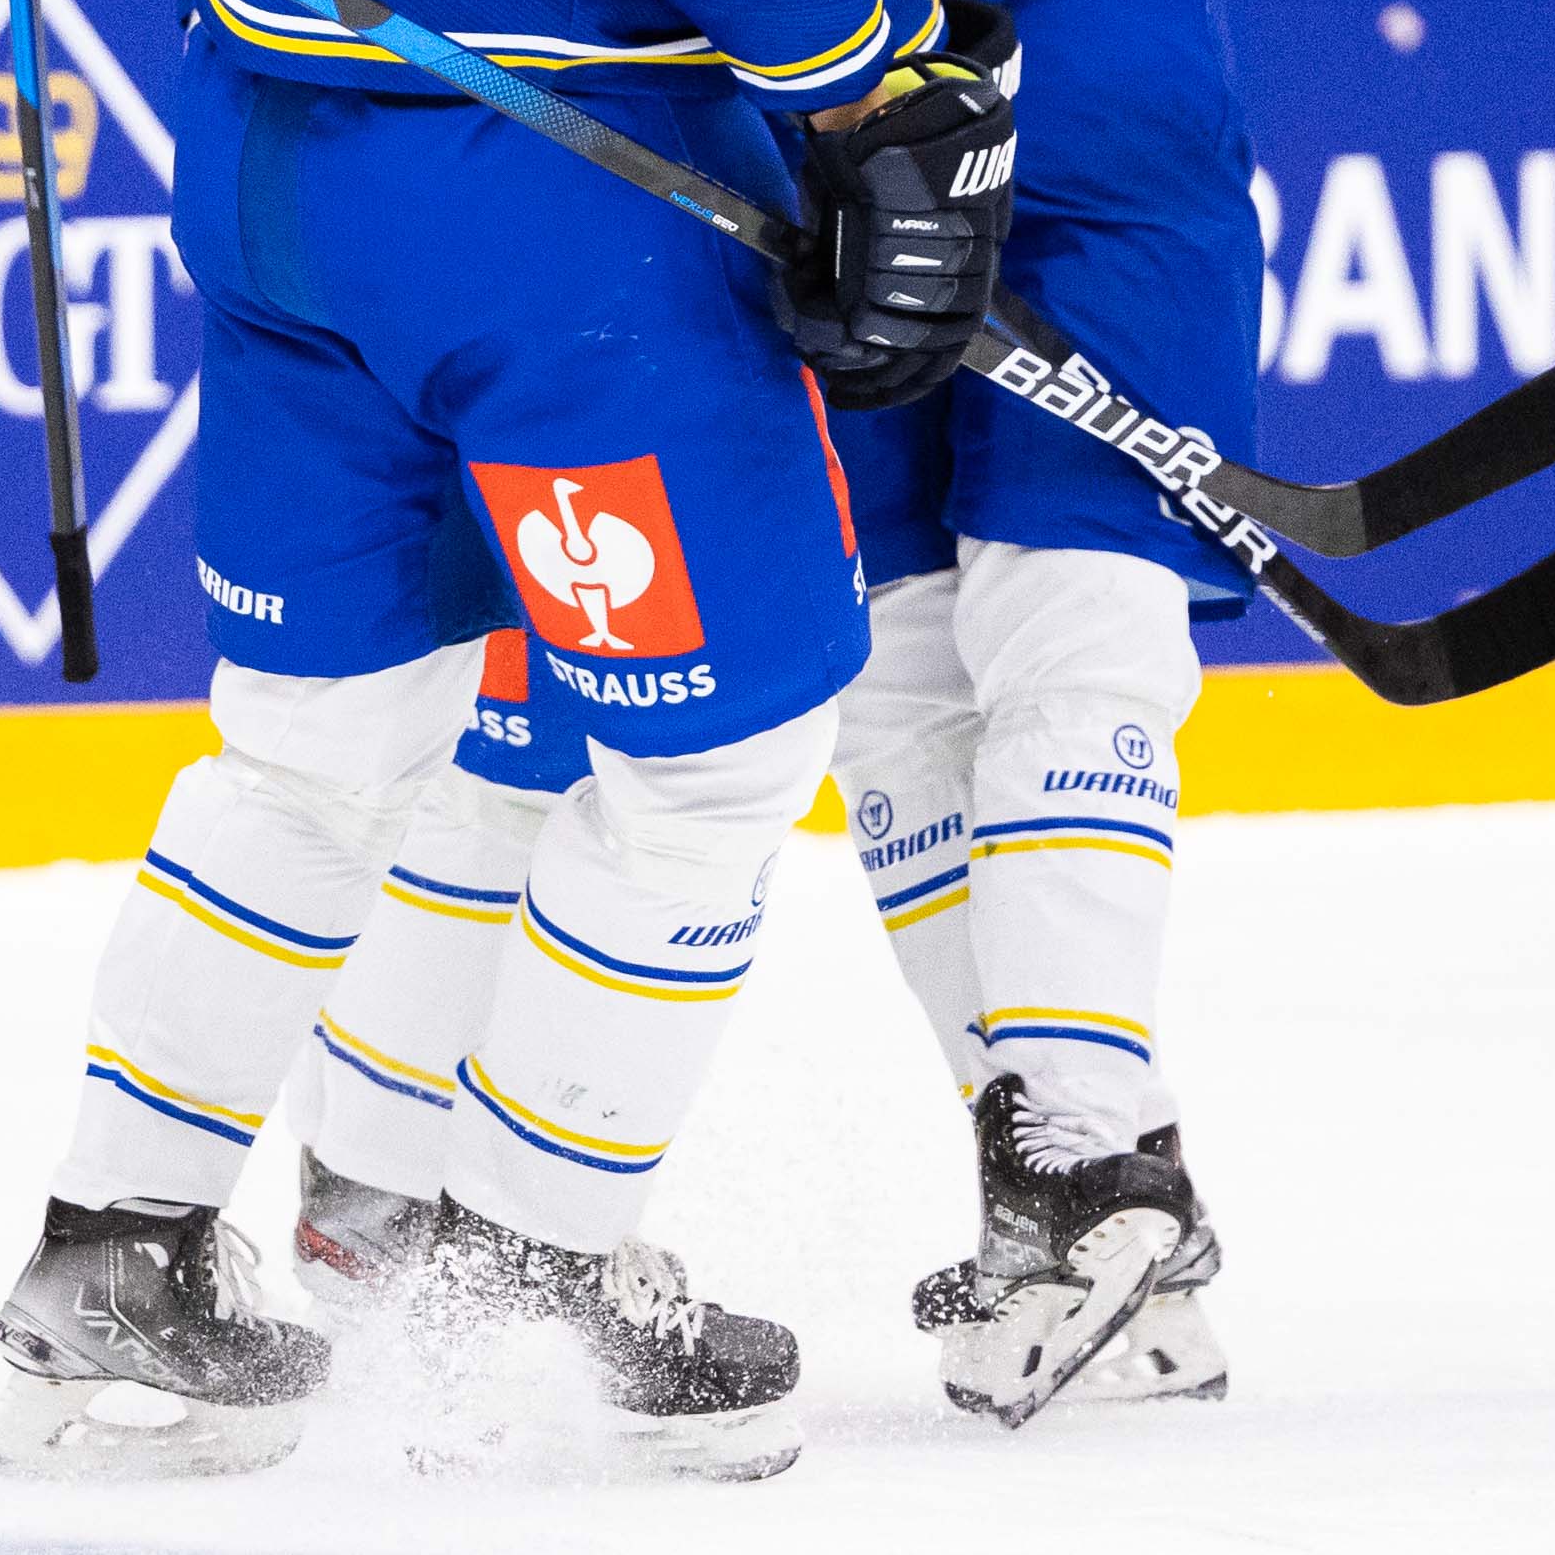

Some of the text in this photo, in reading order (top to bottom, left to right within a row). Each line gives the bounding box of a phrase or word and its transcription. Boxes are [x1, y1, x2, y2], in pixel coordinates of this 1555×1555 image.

[987, 346, 1222, 491] BAUER
[545, 650, 717, 708] STRAUSS
[467, 708, 533, 749] SS
[1044, 770, 1179, 811] WARRIO
